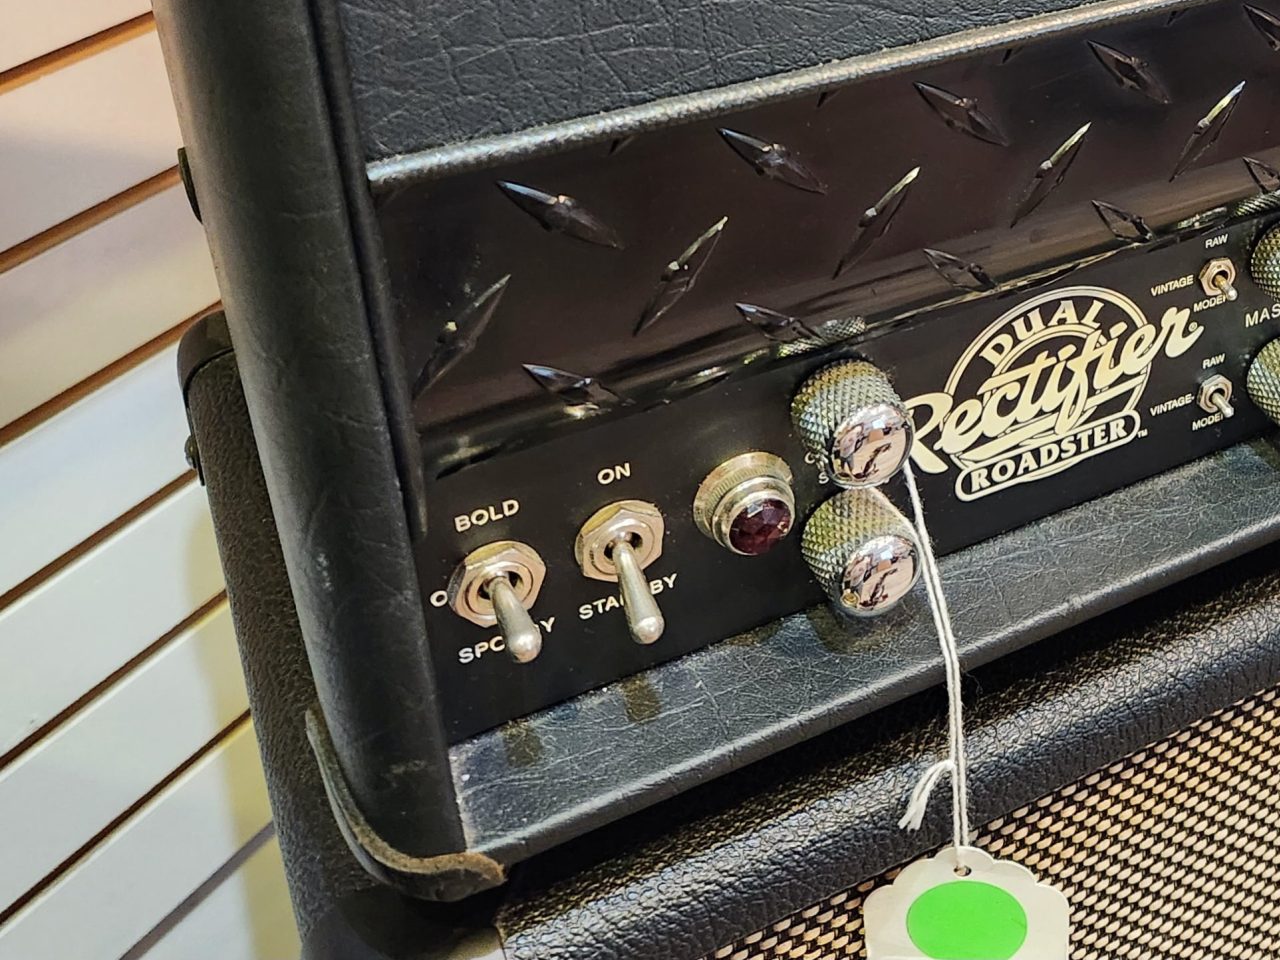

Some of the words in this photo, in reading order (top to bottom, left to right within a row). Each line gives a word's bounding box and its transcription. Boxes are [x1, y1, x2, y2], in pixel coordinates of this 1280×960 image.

[1205, 234, 1229, 249] RAW
[1150, 274, 1194, 297] VINTAGE
[1193, 294, 1227, 313] MODE
[979, 299, 1107, 368] DUAL
[1202, 353, 1226, 369] RAW
[904, 306, 1205, 475] Rectifier
[1192, 412, 1224, 431] MODE
[969, 418, 1129, 493] ROADSTER
[597, 462, 631, 485] ON
[454, 499, 520, 533] BOLD
[578, 573, 678, 621] STABY
